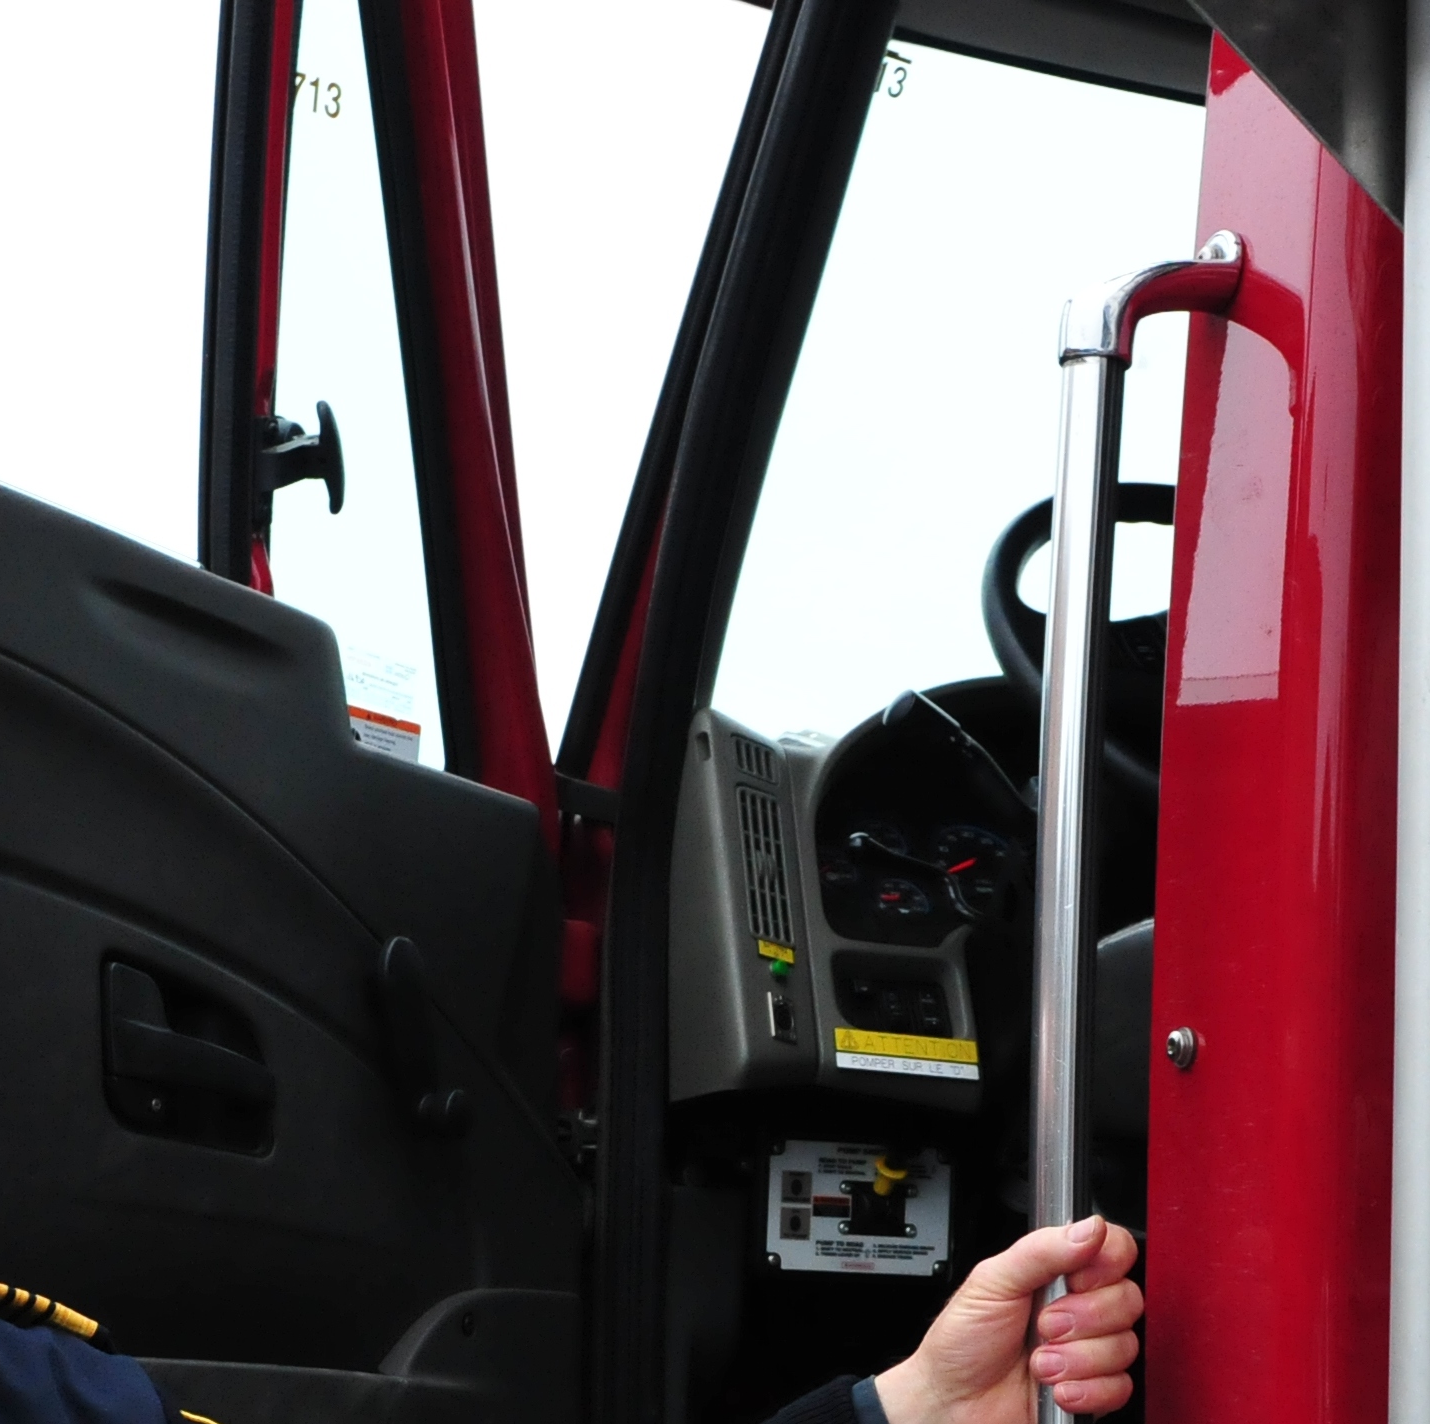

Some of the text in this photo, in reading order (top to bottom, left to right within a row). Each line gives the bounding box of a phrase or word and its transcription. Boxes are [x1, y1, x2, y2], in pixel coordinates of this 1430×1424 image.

[852, 1056, 895, 1069] POMPER
[902, 1061, 922, 1072] SUR
[929, 1064, 943, 1074] LE
